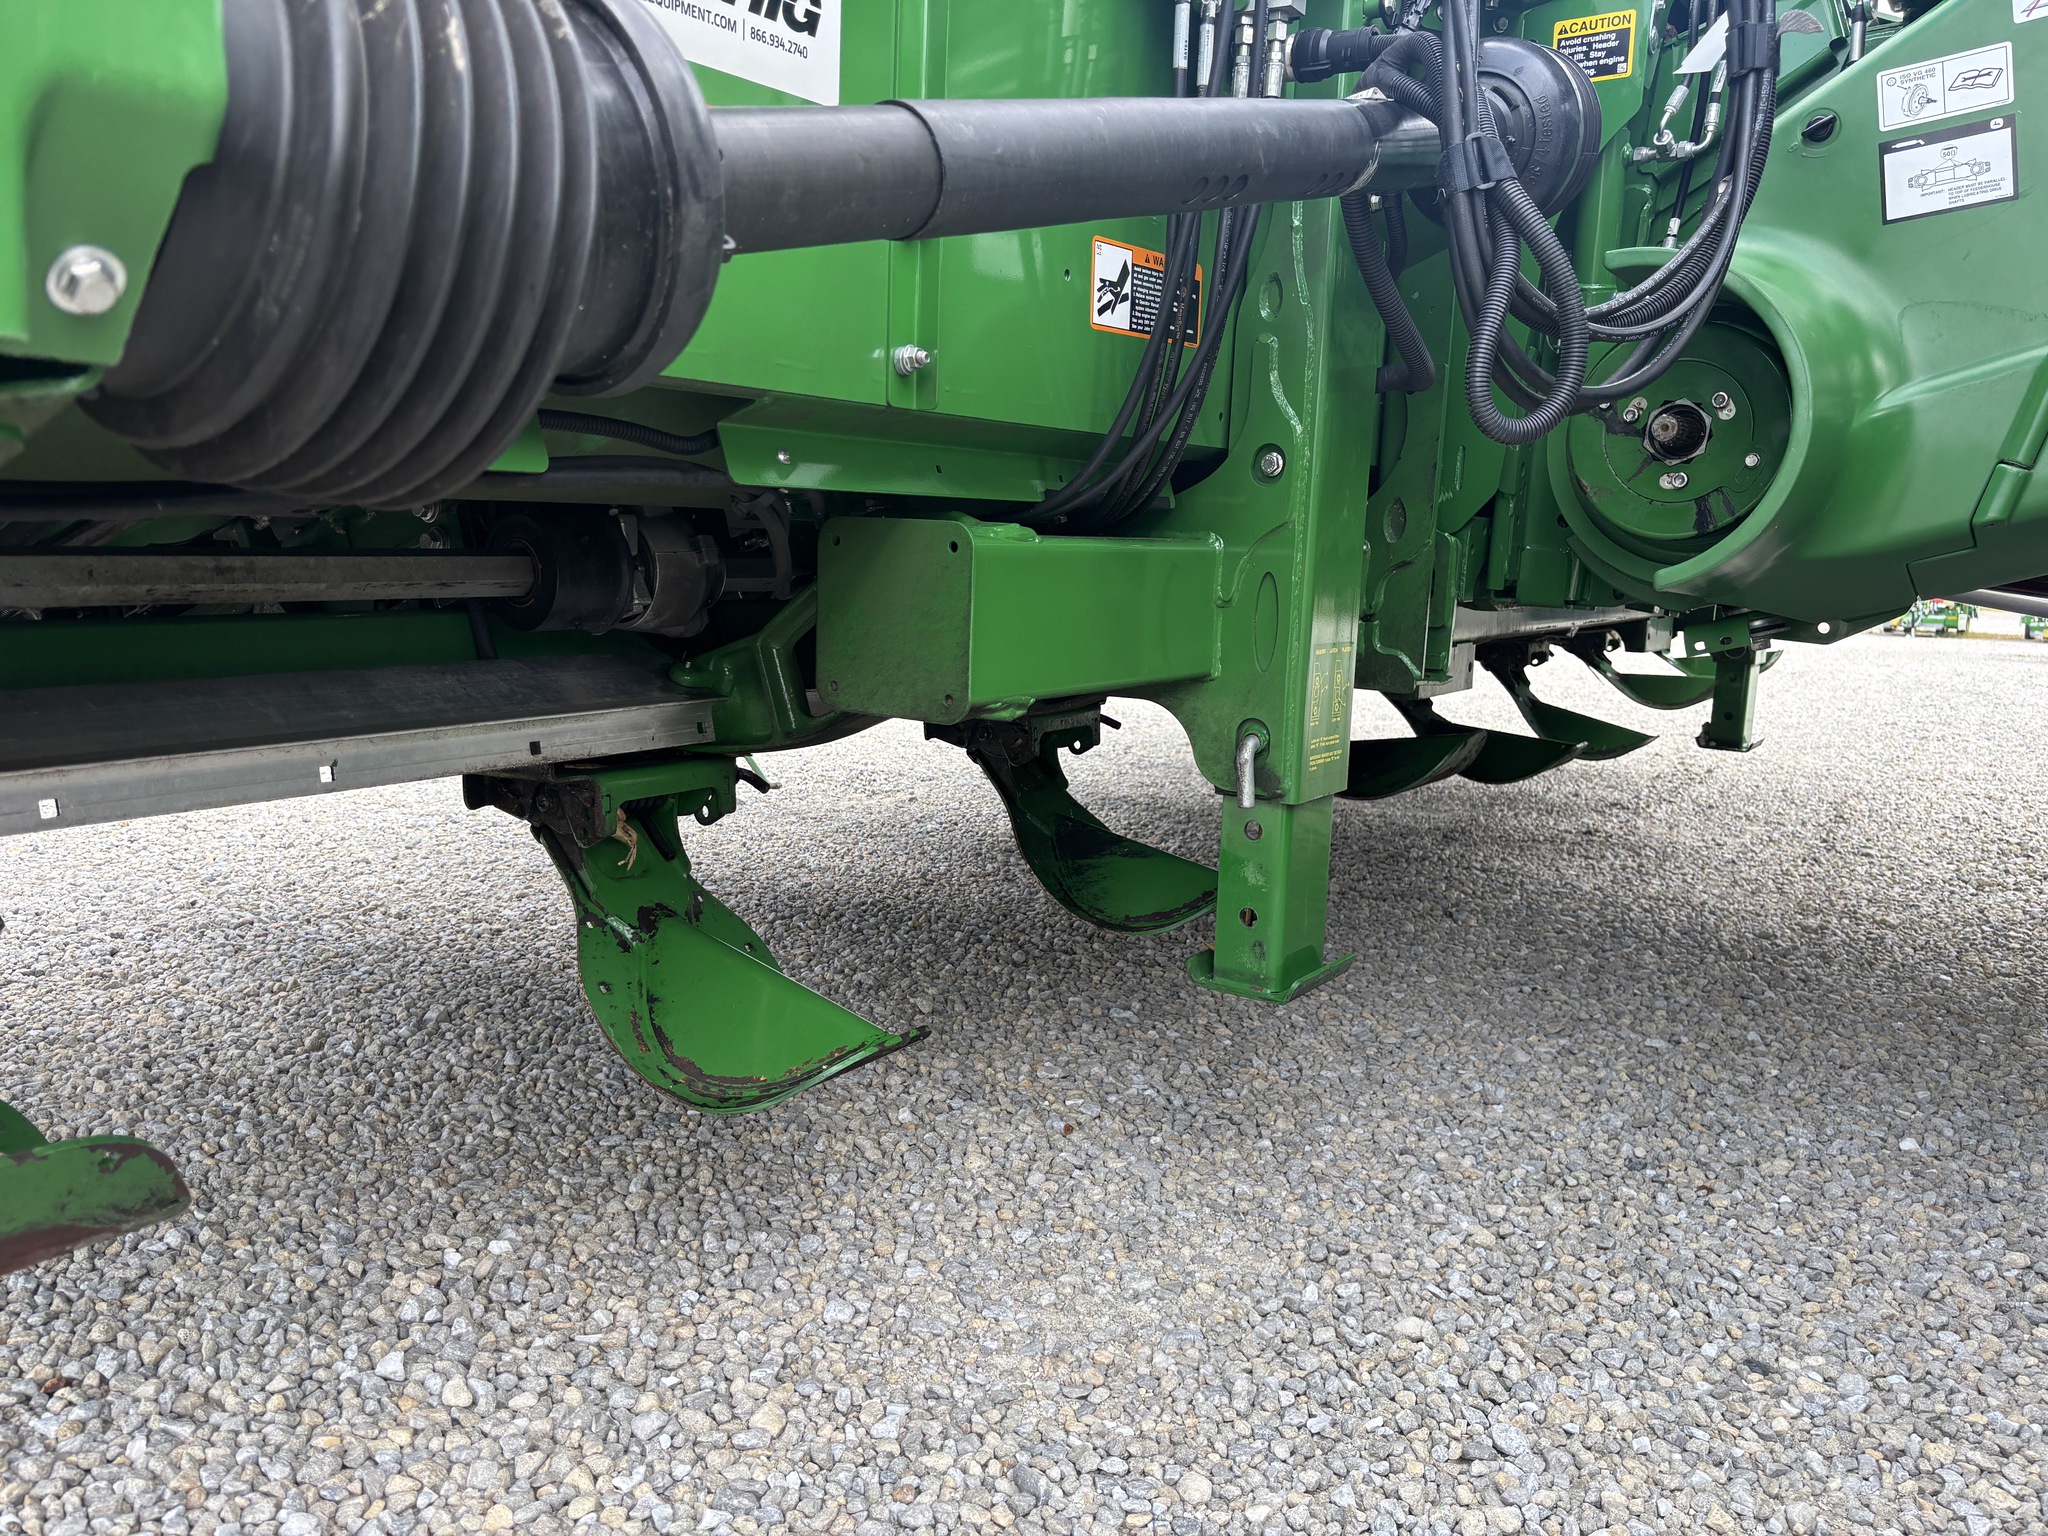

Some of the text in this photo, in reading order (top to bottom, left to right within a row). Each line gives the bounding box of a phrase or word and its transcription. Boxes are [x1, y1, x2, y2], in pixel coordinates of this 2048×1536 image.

[1570, 14, 1631, 33] CAUTION
[750, 26, 808, 59] 866.934.2740
[1560, 33, 1616, 47] Avoid crushing
[1593, 40, 1620, 50] Header
[1590, 51, 1606, 59] Stay
[1599, 56, 1625, 65] engine
[1900, 73, 1936, 85] SYNTHETIC
[1533, 93, 1553, 142] tested
[1626, 292, 1637, 303] MPa
[1670, 248, 1692, 270] exceeds
[1689, 237, 1702, 249] SAE
